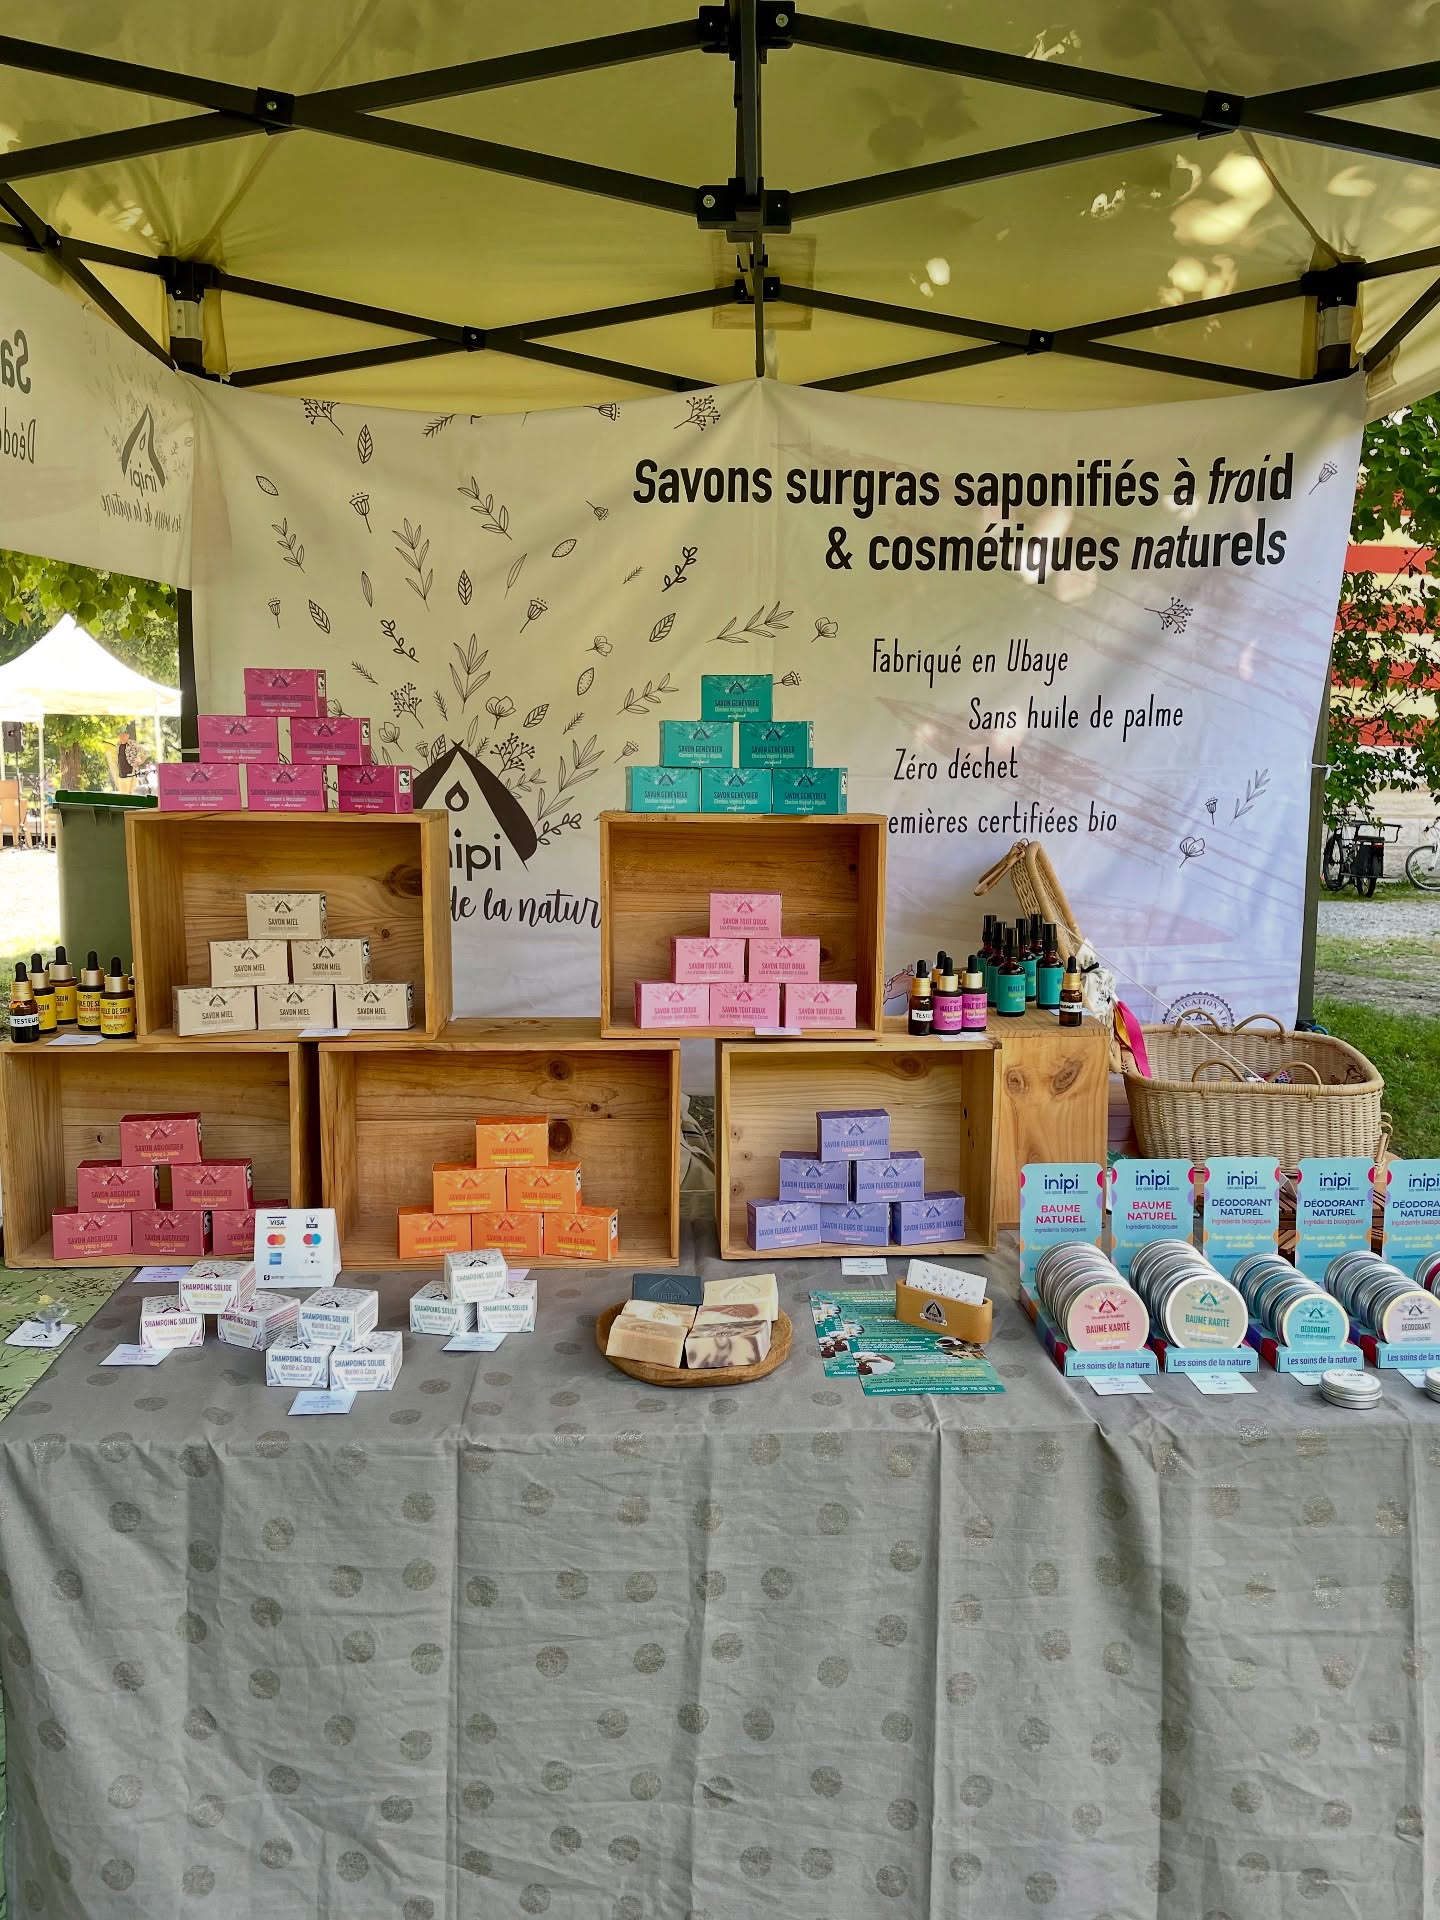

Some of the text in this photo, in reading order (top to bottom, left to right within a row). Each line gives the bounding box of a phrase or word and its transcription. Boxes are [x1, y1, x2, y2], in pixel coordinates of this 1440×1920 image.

[633, 452, 1294, 520] Savons surgras saponifiés à froid
[825, 519, 1287, 584] & cosmétiques naturels
[872, 638, 1069, 688] Fabriqué en Ubaye
[969, 694, 1184, 742] Sans huile de palme
[894, 747, 1018, 780] Zéro déchet
[888, 800, 1117, 834] emières certifiées bio
[484, 888, 512, 921] la
[519, 889, 601, 928] natur
[279, 1008, 310, 1016] SAVON MIEL
[357, 1007, 386, 1015] SAVON MIEL
[202, 1012, 220, 1020] SAVON
[1044, 1173, 1079, 1194] inipi
[1136, 1168, 1170, 1190] inipi
[1227, 1171, 1258, 1189] inipi
[1320, 1172, 1351, 1191] inipi
[1409, 1173, 1440, 1191] inipi
[1133, 1201, 1172, 1210] BAUME
[1212, 1198, 1272, 1207] DÉODORANT
[1304, 1198, 1365, 1208] DÉODORANT
[1393, 1200, 1440, 1209] DÉODORA
[1041, 1204, 1080, 1213] BAUME
[1220, 1208, 1263, 1216] NATUREL
[1312, 1208, 1355, 1216] NATUREL
[1035, 1215, 1085, 1224] NATUREL
[1127, 1212, 1177, 1220] NATUREL
[1212, 1218, 1239, 1226] Ingrédients
[182, 1283, 213, 1291] SHAMPOING
[414, 1304, 441, 1314] SHAMPOING
[302, 1312, 350, 1323] SHAMPOING SOLIDE
[1185, 1314, 1230, 1327] BAUME KARITÉ
[145, 1319, 177, 1327] SHAMPOING
[1402, 1322, 1431, 1331] DÉODORANT
[1086, 1322, 1131, 1334] BAUME KARITÉ
[1300, 1325, 1330, 1334] DÉODORANT
[271, 1355, 321, 1364] SHAMPOING SOLIDE
[1174, 1359, 1188, 1367] Les
[1190, 1359, 1208, 1367] soins
[1218, 1358, 1224, 1366] la
[1287, 1357, 1299, 1365] Les
[1300, 1356, 1317, 1364] soins
[1319, 1356, 1326, 1364] de
[1387, 1354, 1399, 1362] Les
[1073, 1362, 1087, 1370] Les
[1089, 1362, 1108, 1370] soins
[1126, 1361, 1150, 1369] nature
